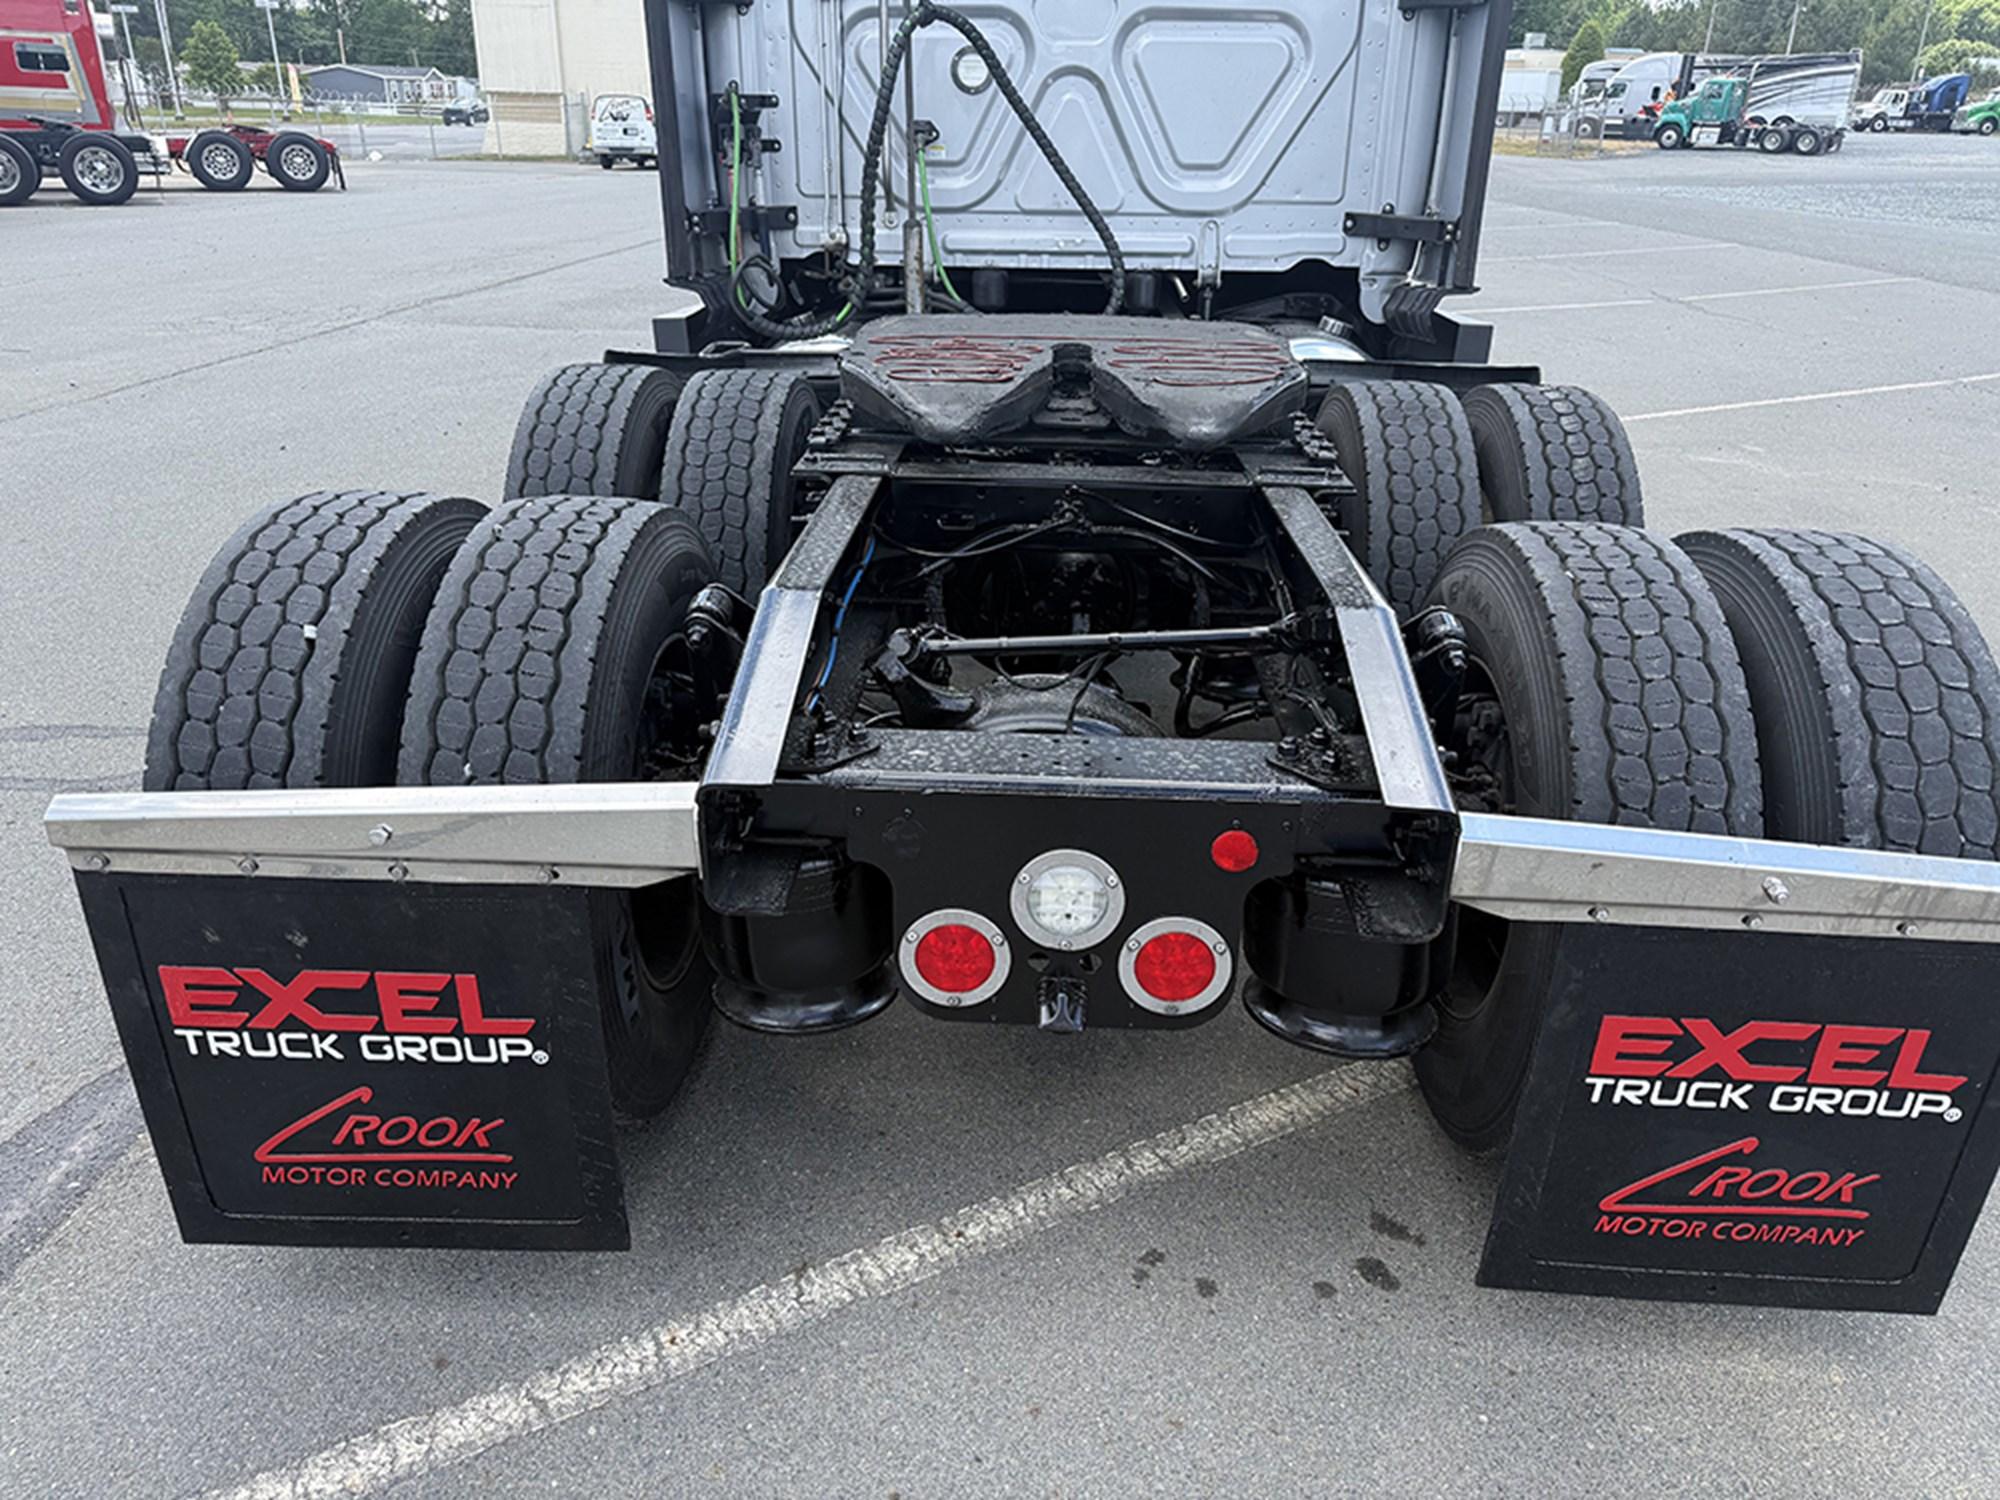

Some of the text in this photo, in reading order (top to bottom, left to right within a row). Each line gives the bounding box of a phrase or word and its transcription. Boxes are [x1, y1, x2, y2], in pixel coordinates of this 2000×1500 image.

[158, 965, 536, 1035] EXCEL
[173, 1028, 344, 1060] TRUCK
[1589, 1014, 1969, 1092] EXCEL
[1584, 1077, 1754, 1110] TRUCK
[262, 1166, 518, 1190] MOTOR COMPANY
[1594, 1215, 1865, 1248] MOTOR COMPANY
